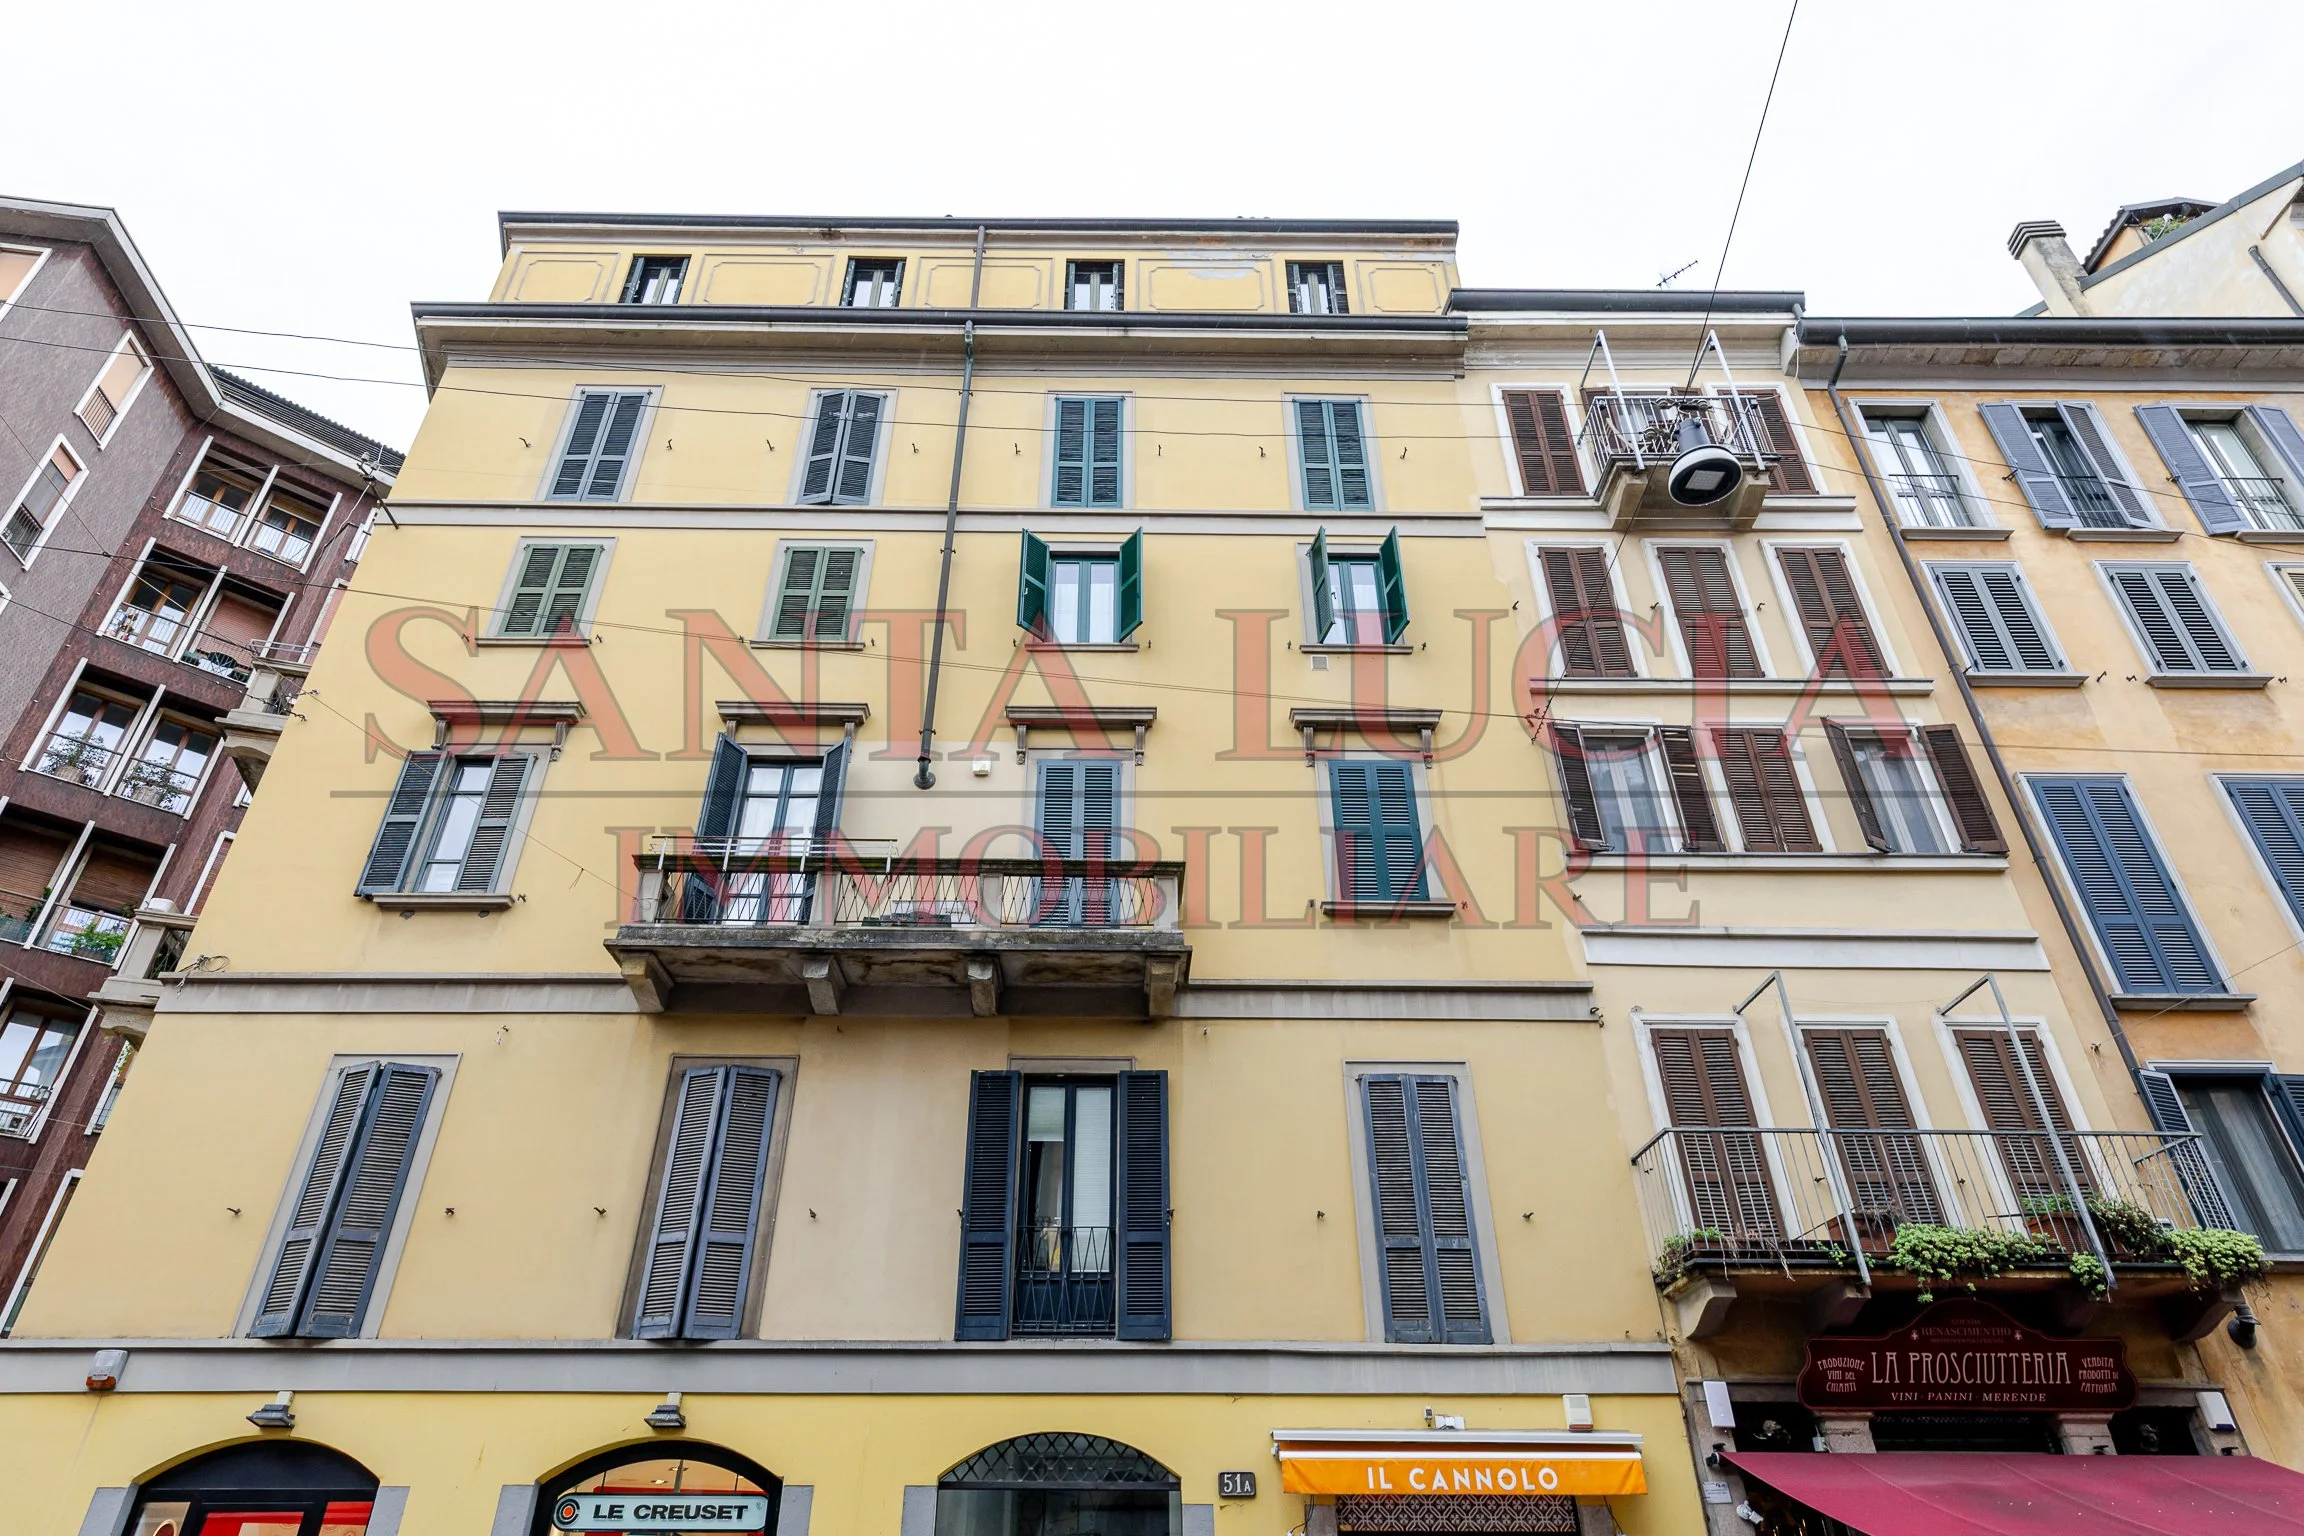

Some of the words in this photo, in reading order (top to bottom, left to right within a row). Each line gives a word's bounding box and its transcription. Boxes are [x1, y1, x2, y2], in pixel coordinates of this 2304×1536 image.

[1816, 1357, 1866, 1371] PRODUZIONE
[1871, 1351, 1900, 1384] LA
[1908, 1351, 2071, 1385] PROSCIUTTERIA
[2081, 1356, 2114, 1369] VENDITA
[1827, 1370, 1842, 1380] VINI
[2078, 1369, 2111, 1380] PRODOTTI
[1825, 1381, 1857, 1393] CHIANTI
[2080, 1382, 2118, 1394] FATTORIA
[1891, 1392, 1918, 1401] VINI
[1927, 1392, 1973, 1401] PANINI
[1982, 1392, 2047, 1402] MERENDE
[1367, 1466, 1393, 1490] IL
[1409, 1467, 1559, 1491] CANNOLO
[593, 1504, 625, 1520] LE
[633, 1504, 749, 1520] CREUSET
